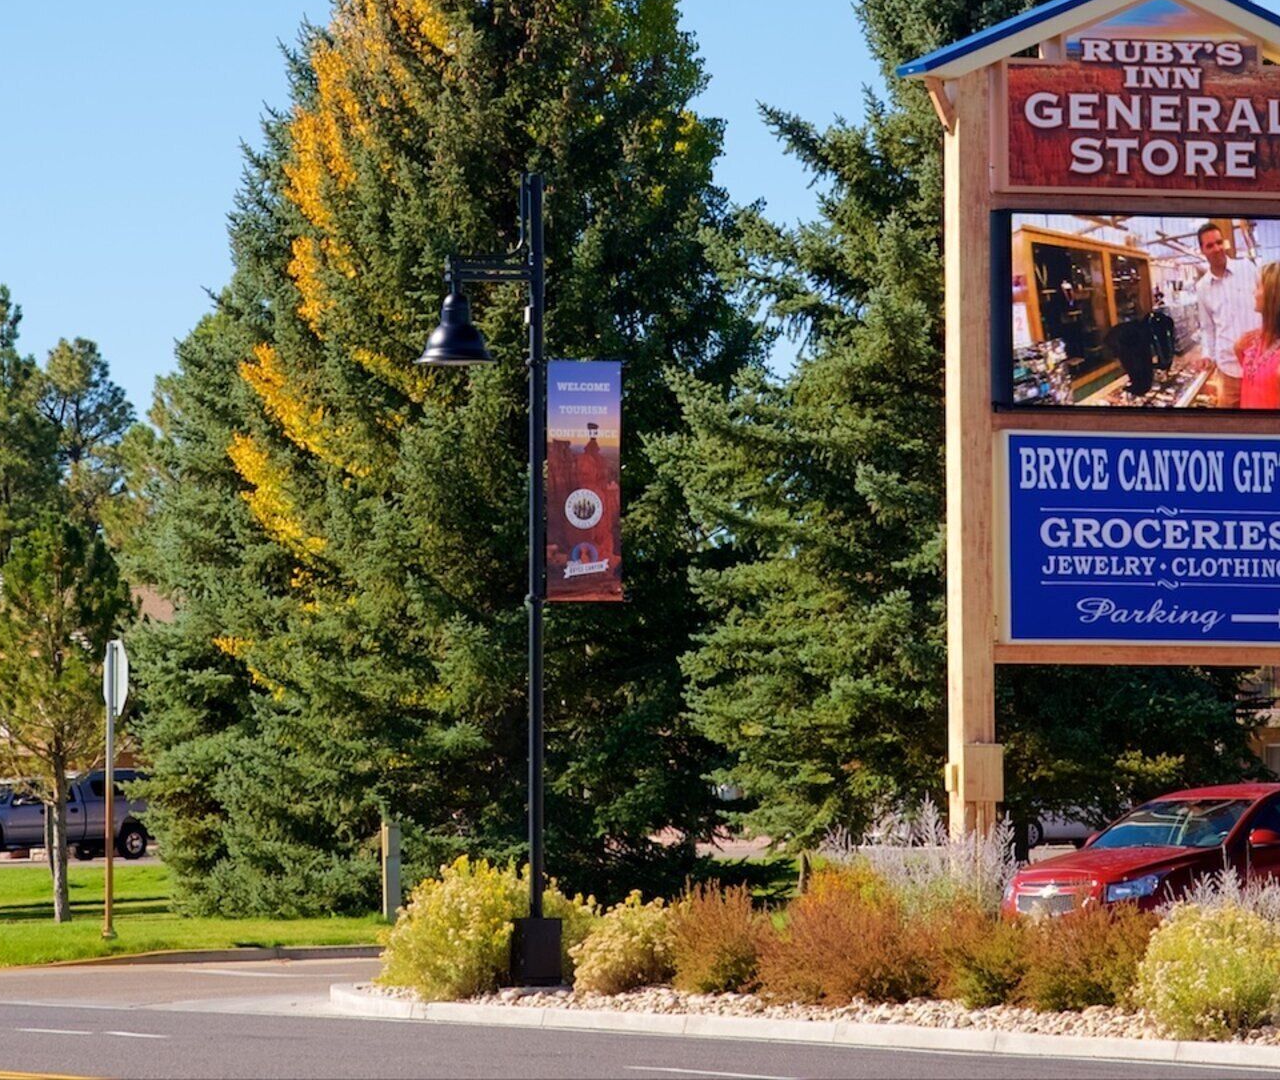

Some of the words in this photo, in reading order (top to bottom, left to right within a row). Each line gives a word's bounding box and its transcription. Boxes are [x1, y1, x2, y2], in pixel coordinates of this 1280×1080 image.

[1081, 38, 1243, 66] RUBY'S
[1123, 66, 1201, 90] INN
[1069, 138, 1257, 178] STORE
[557, 382, 610, 392] WELCOME
[559, 405, 608, 415] TOURISM
[549, 429, 618, 438] CONFERENCE
[1019, 447, 1110, 490] BRYCE
[1118, 449, 1224, 493] CANYON
[1042, 556, 1156, 576] JEWELRY
[1076, 597, 1226, 633] Parking
